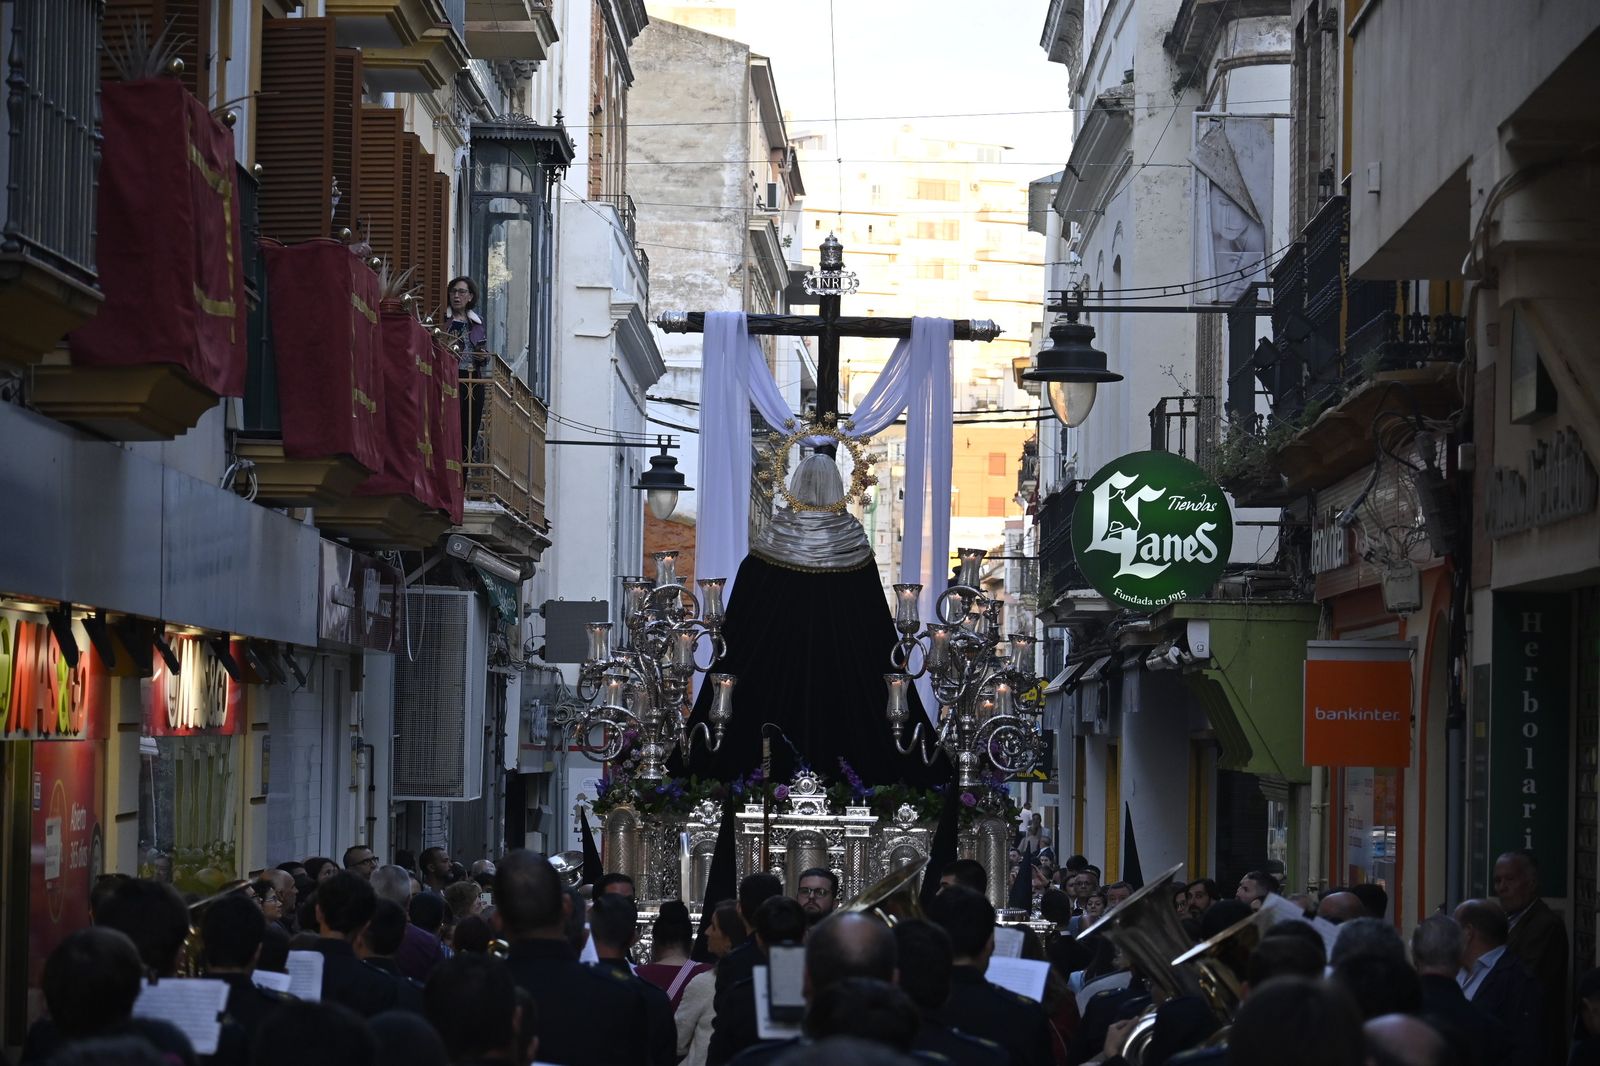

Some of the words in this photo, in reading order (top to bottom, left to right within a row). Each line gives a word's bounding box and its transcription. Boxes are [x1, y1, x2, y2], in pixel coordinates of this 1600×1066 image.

[1167, 493, 1218, 512] Tiendas
[1113, 587, 1153, 606] Fundada
[1155, 597, 1167, 606] en
[1168, 590, 1187, 603] 1915
[1521, 612, 1542, 849] Herbolari
